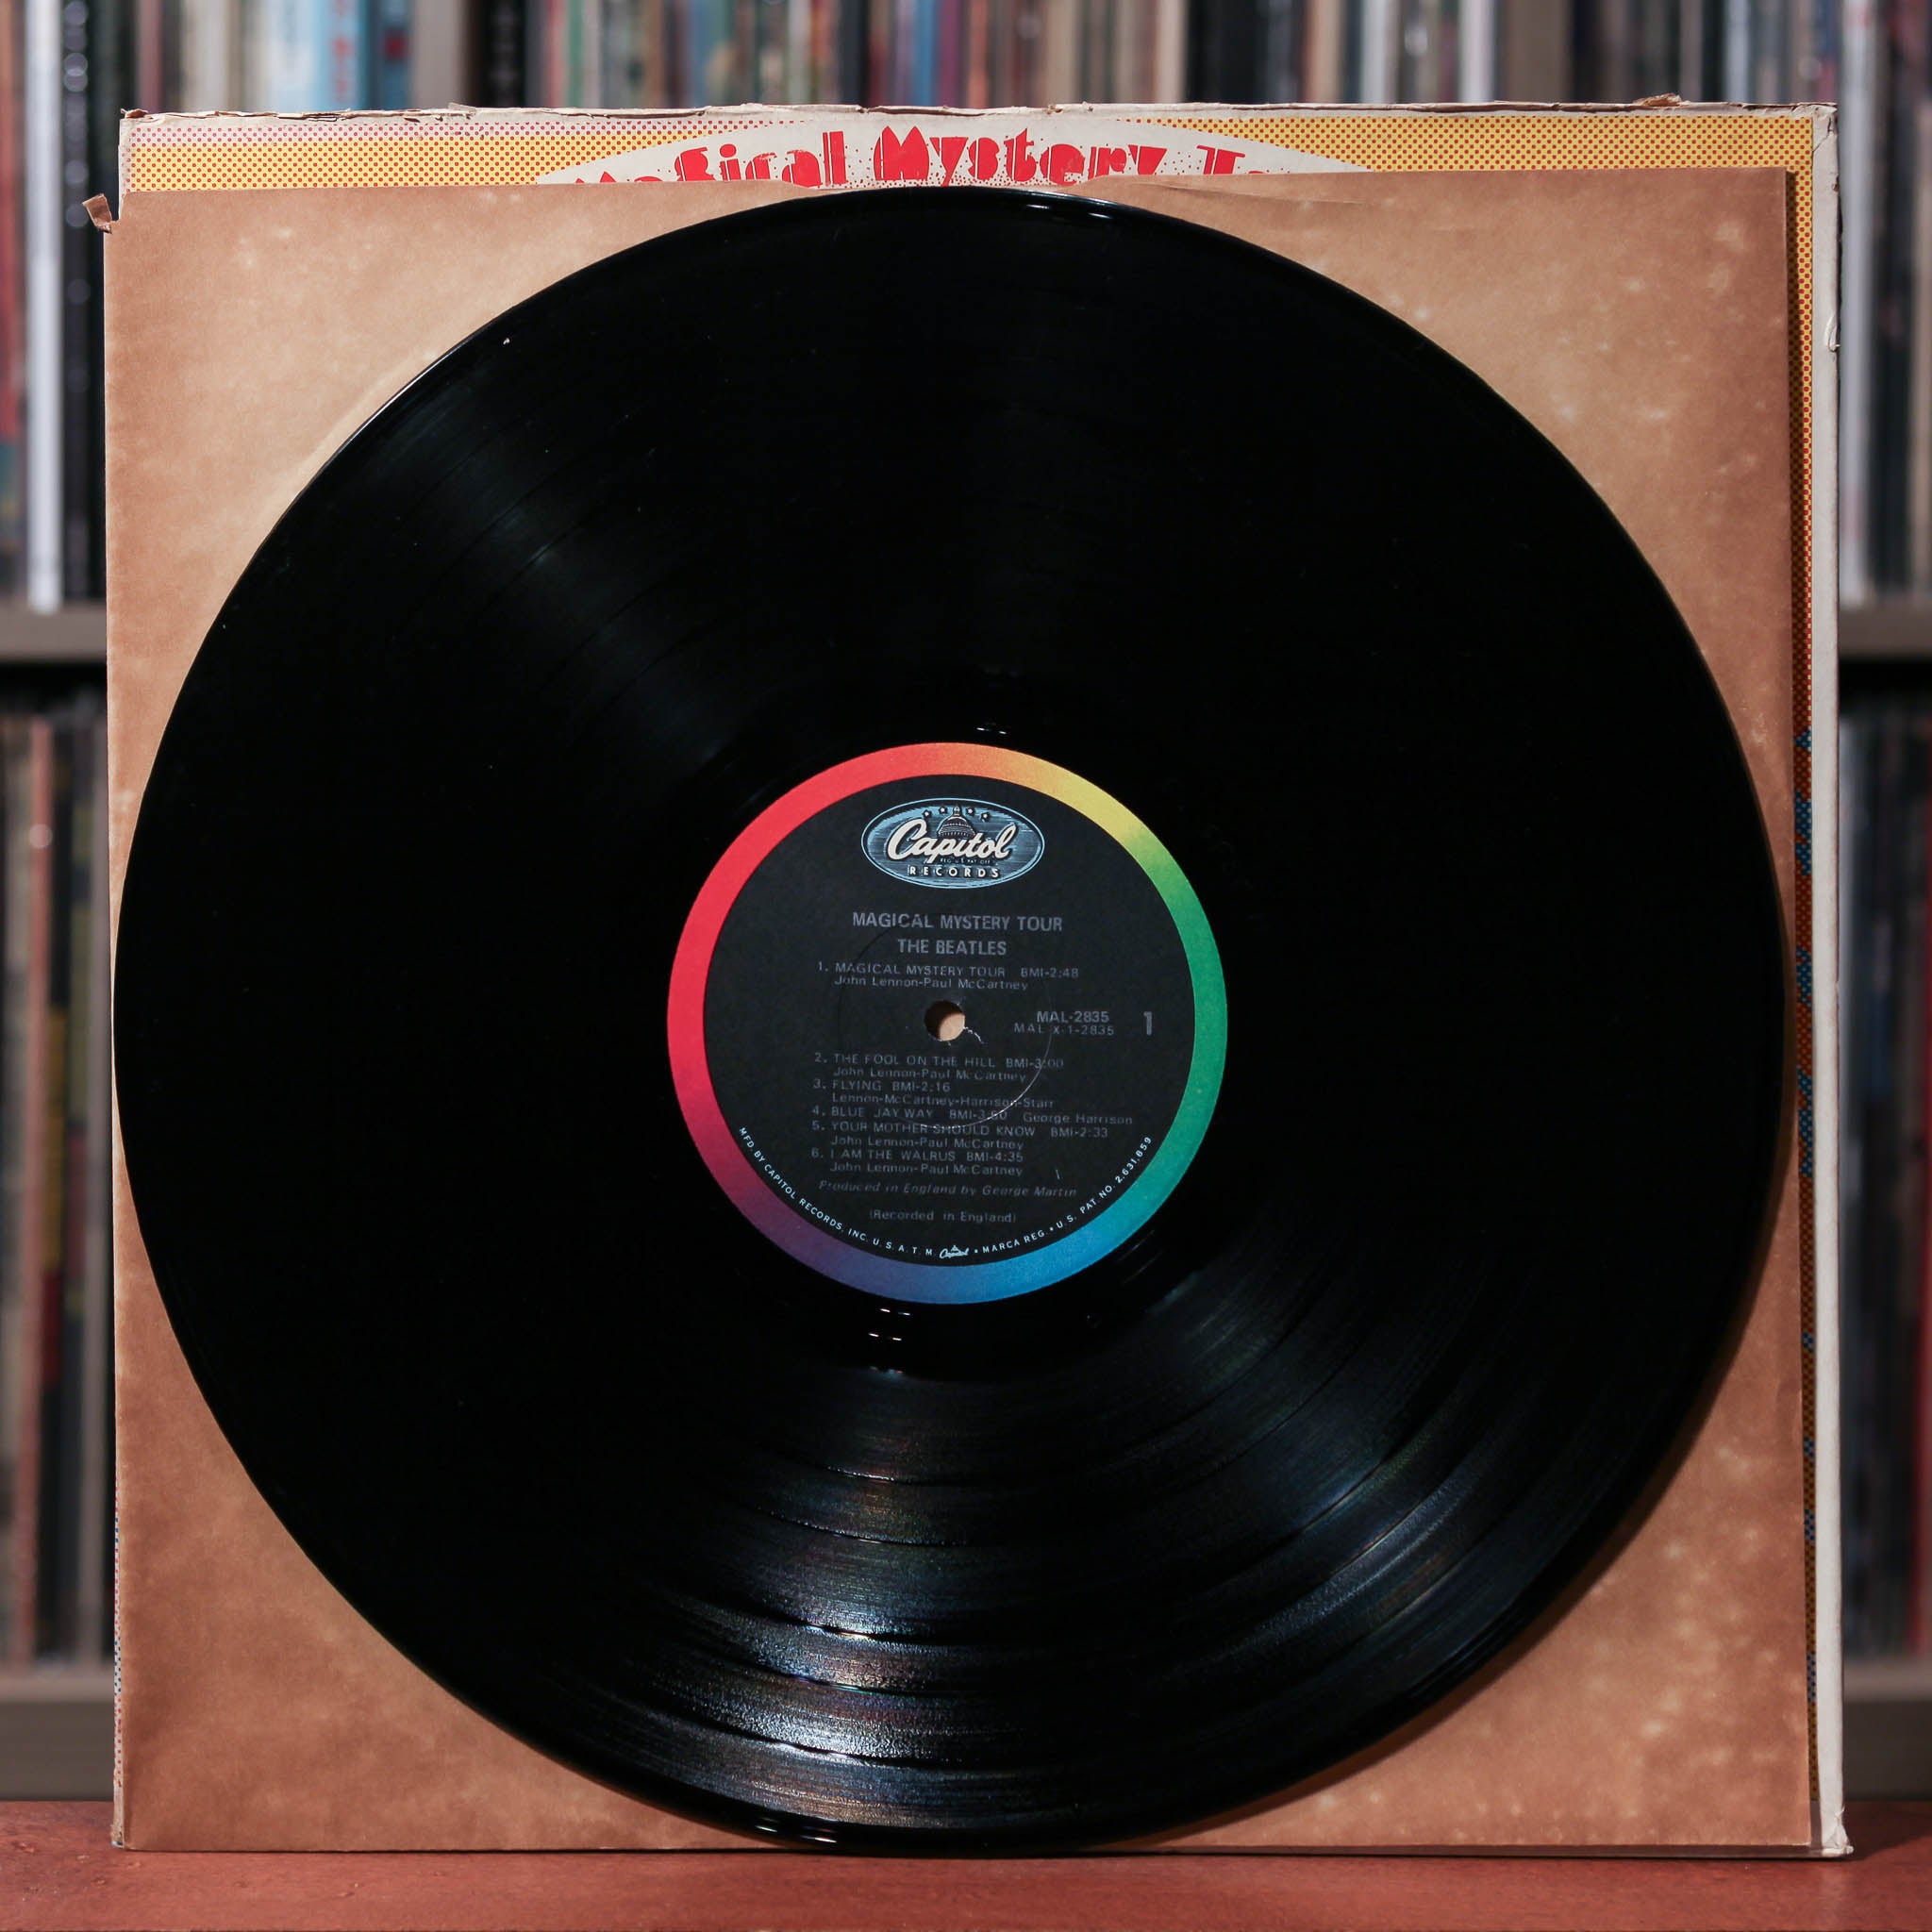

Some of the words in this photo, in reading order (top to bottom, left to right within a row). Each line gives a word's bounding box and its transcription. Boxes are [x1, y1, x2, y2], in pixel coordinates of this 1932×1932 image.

[575, 131, 848, 188] gical
[887, 818, 1016, 864] Capitol
[908, 866, 1000, 878] RECORDS
[853, 912, 934, 929] MAGICAL
[940, 914, 1010, 930] MYSTERY
[1017, 916, 1063, 932] TOUR
[898, 939, 929, 954] THE
[936, 940, 1008, 956] BEATLES
[818, 961, 828, 973] 1.
[835, 962, 900, 974] MAGICAL
[907, 965, 963, 976] MYSTERY
[970, 966, 1006, 977] TOUR
[1021, 967, 1079, 978] BMI-2:48
[834, 975, 866, 986] John
[872, 976, 952, 989] Lennon-Paul
[958, 979, 1028, 991] McCartney
[1014, 1023, 1044, 1034] MAL
[1036, 1010, 1110, 1024] MAL-2835
[1143, 1011, 1153, 1036] 1
[814, 1052, 827, 1063] 2.
[833, 1053, 859, 1064] THE
[865, 1054, 899, 1065] FOOL
[907, 1056, 927, 1066] ON
[933, 1056, 958, 1067] THE
[964, 1057, 995, 1068] HILL
[833, 1067, 864, 1077] John
[870, 1067, 950, 1079] Lennon-Paul
[956, 1070, 1026, 1083] McCartney
[813, 1078, 826, 1090] 3.
[832, 1079, 882, 1091] FLYING
[811, 1105, 825, 1116] 4.
[831, 1107, 864, 1117] BLUE
[873, 1108, 897, 1118] JAY
[905, 1108, 934, 1119] WAY
[1023, 1111, 1070, 1124] George
[1075, 1113, 1133, 1125] Harrison
[811, 1120, 824, 1131] 5.
[831, 1121, 867, 1132] YOUR
[873, 1123, 928, 1134] MOTHER
[933, 1124, 990, 1136] SHOULD
[996, 1125, 1036, 1137] KNOW
[1050, 1126, 1108, 1138] BMI-2:33
[831, 1135, 862, 1146] John
[868, 1136, 948, 1148] Lennon-Paul
[954, 1139, 1024, 1151] McCartney
[811, 1148, 824, 1158] 6.
[830, 1148, 834, 1158] I
[839, 1149, 862, 1159] AM
[868, 1149, 892, 1160] THE
[901, 1150, 956, 1161] WALRUS
[966, 1151, 1024, 1163] BMI-4:35
[830, 1162, 861, 1173] John
[954, 1164, 1024, 1177] McCartney
[818, 1180, 881, 1192] Produced
[885, 1183, 899, 1193] in
[904, 1183, 956, 1195] England
[960, 1185, 975, 1196] by
[982, 1185, 1028, 1197] George
[1034, 1186, 1077, 1197] Martin
[754, 1150, 766, 1162] BY
[764, 1164, 797, 1199] CAPITOL
[982, 1239, 1020, 1254] MARCA
[943, 1210, 955, 1221] in
